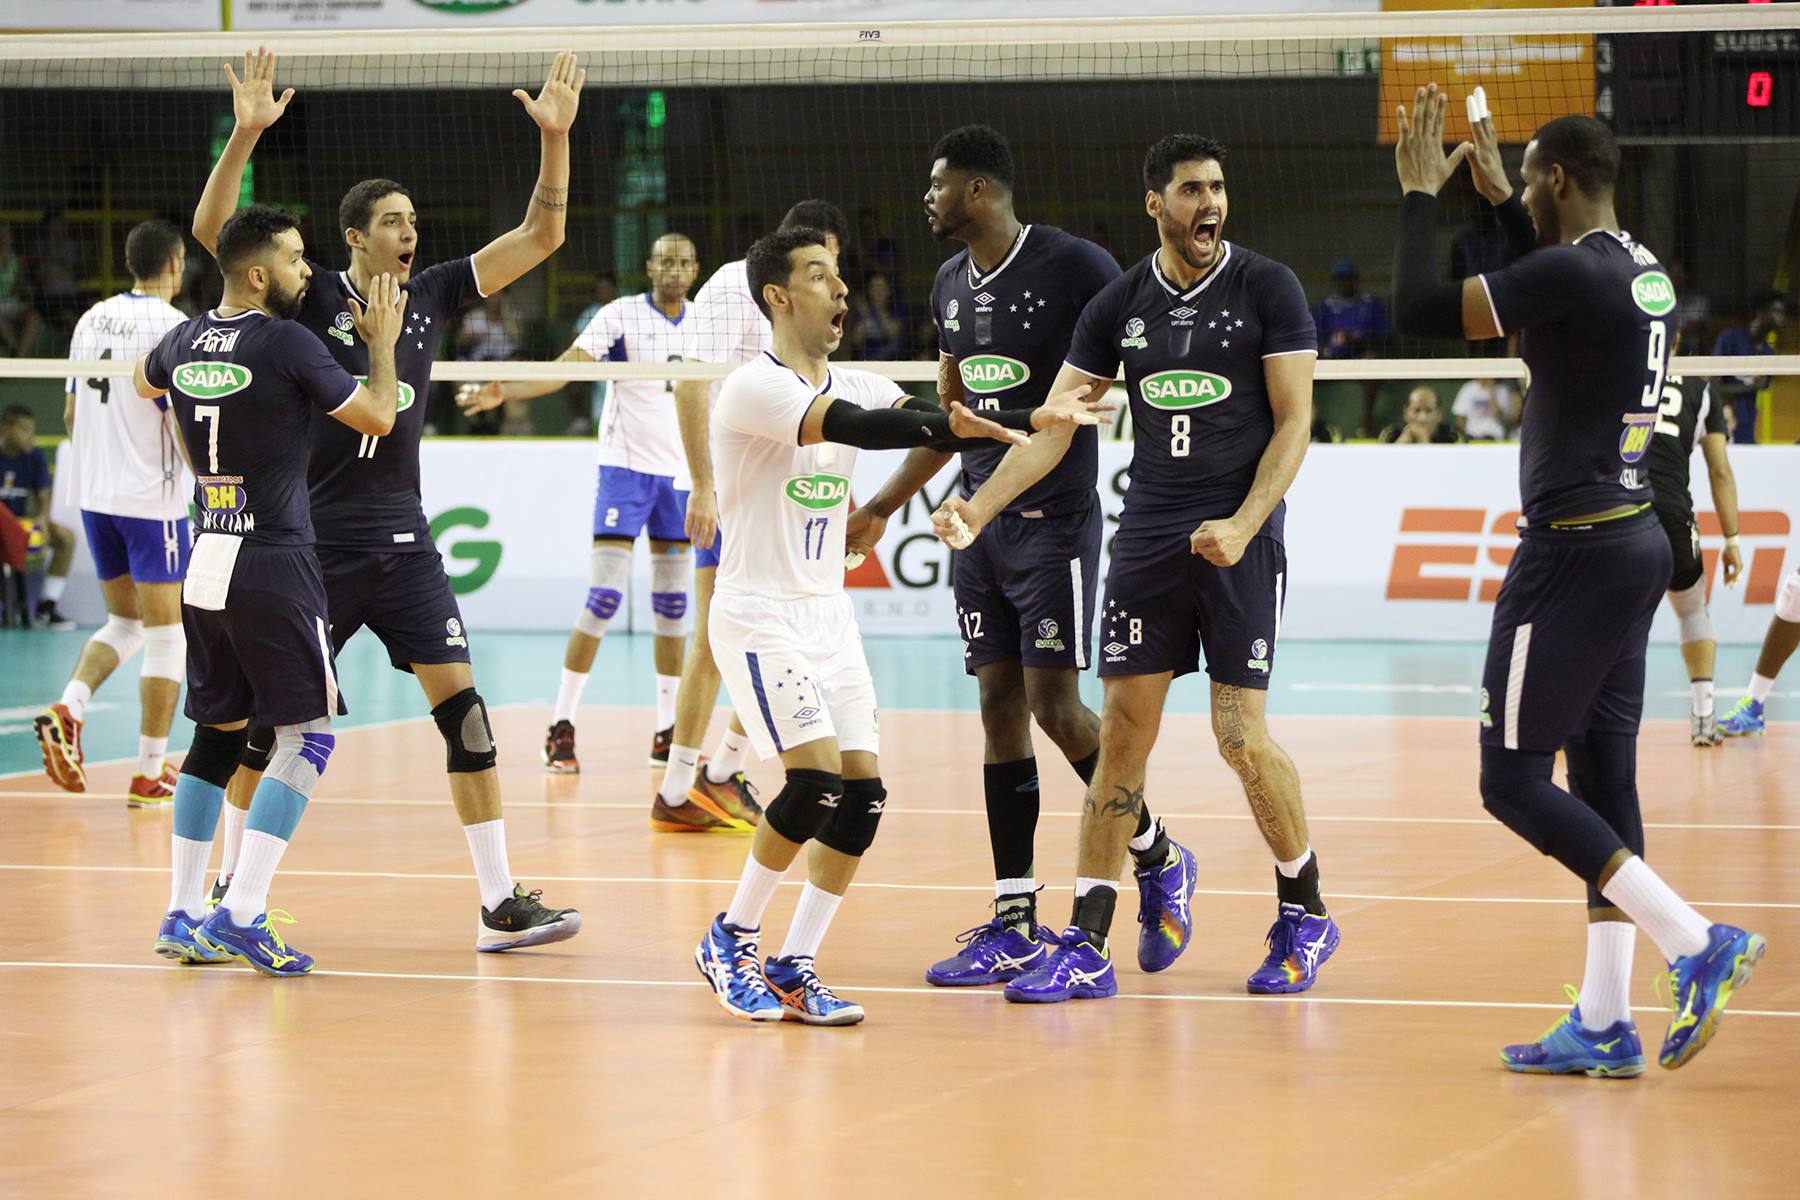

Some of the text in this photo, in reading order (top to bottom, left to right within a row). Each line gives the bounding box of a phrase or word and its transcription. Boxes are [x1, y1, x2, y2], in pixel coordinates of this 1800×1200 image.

[1746, 71, 1773, 107] 0
[1637, 281, 1672, 303] SADA
[190, 327, 241, 353] Amil
[962, 363, 1017, 382] SADA
[1641, 321, 1667, 407] 9
[181, 367, 240, 388] SADA
[1145, 378, 1218, 399] SADA
[194, 405, 221, 474] 7
[1171, 414, 1191, 457] 8
[205, 485, 237, 509] BH
[792, 479, 846, 500] SADA
[604, 507, 619, 528] 2
[805, 518, 828, 560] 17
[964, 612, 984, 639] 12
[1129, 618, 1142, 645] 8
